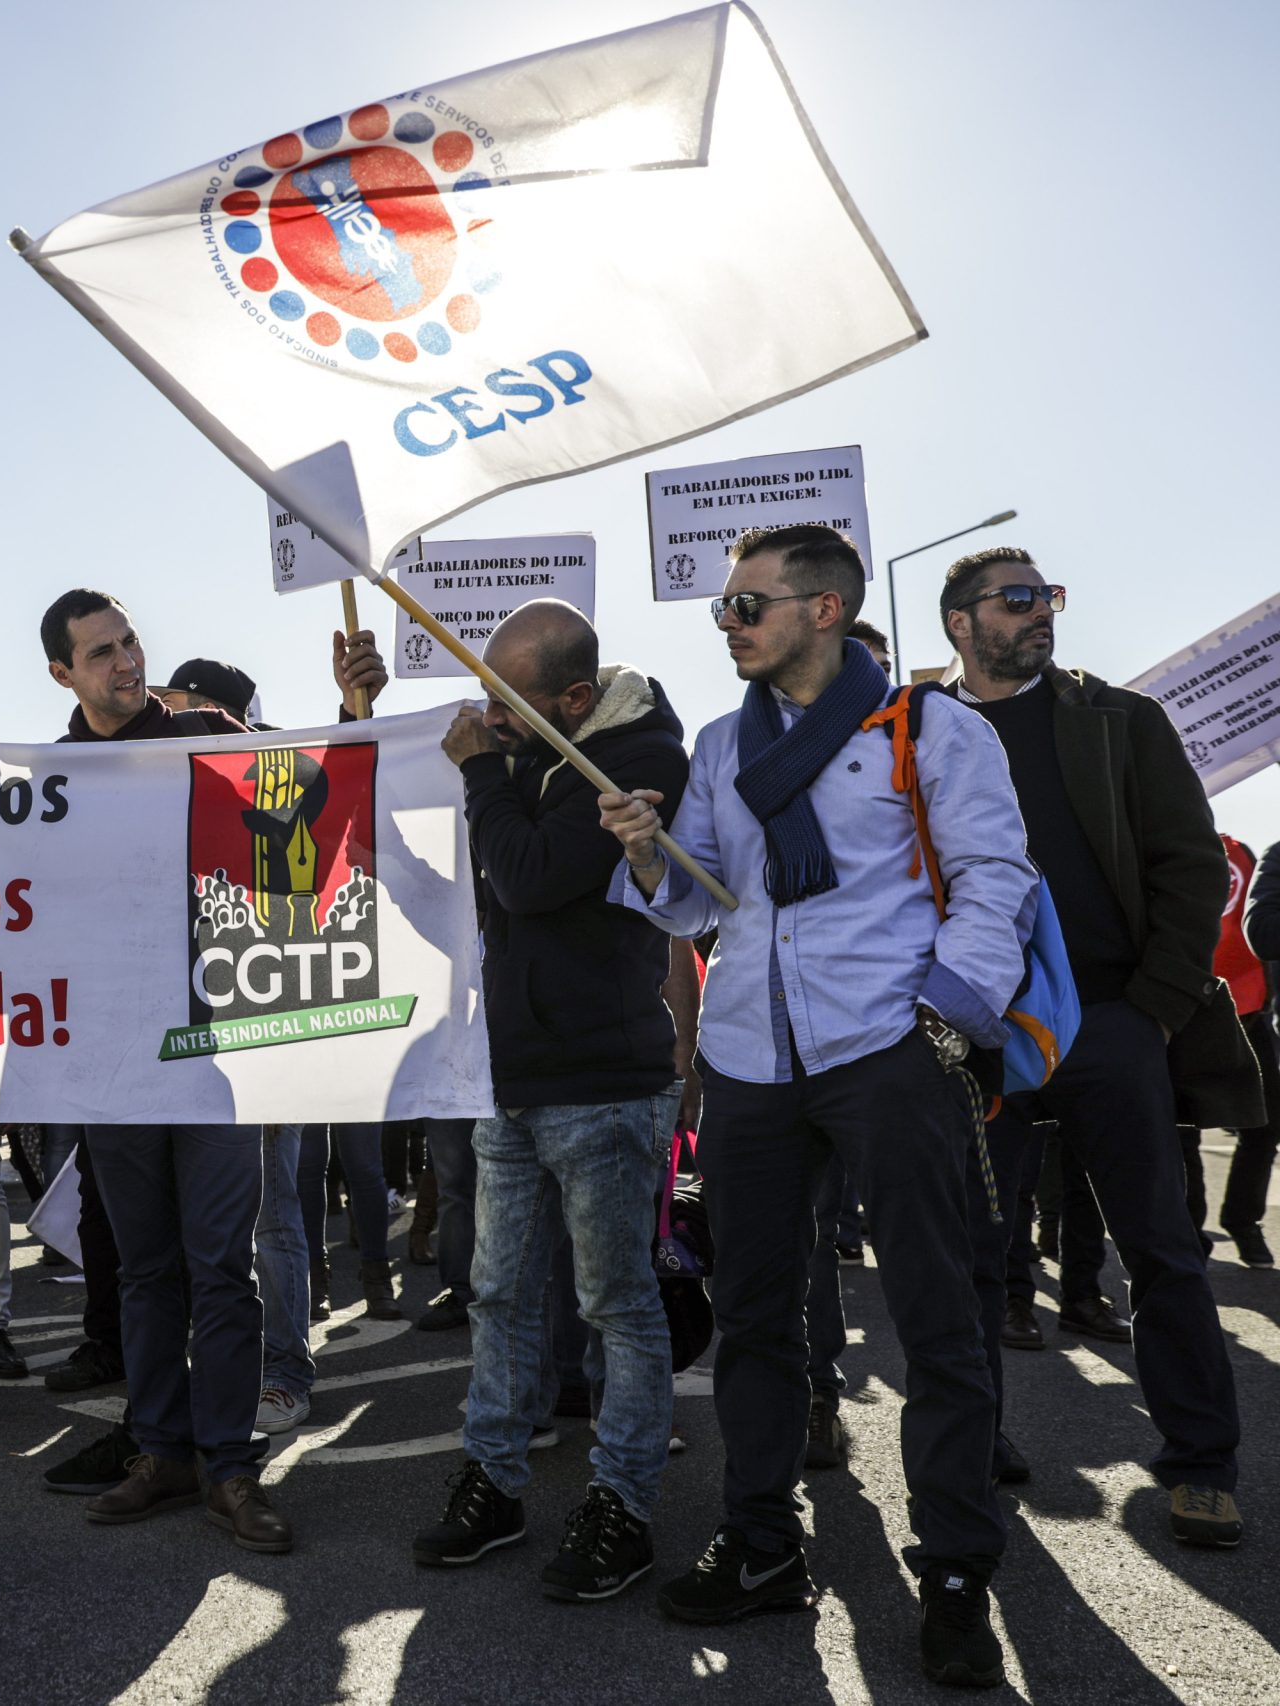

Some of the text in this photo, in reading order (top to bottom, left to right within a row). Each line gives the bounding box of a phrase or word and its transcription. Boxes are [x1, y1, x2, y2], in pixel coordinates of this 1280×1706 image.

[410, 91, 422, 103] E
[424, 95, 495, 149] SERVIÇOS
[206, 176, 224, 196] DO
[240, 299, 267, 326] DOS
[393, 350, 593, 457] CESP
[661, 468, 854, 496] TRABALHADORES DO LIDL
[693, 487, 822, 510] EM LUTA EXIGEM:
[668, 527, 737, 545] REFORÇO
[832, 518, 852, 530] DE
[408, 555, 586, 574] TRABALHADORES DO LIDL
[433, 573, 555, 589] EM LUTA EXIGEM:
[669, 582, 694, 590] CESP
[476, 610, 495, 622] DO
[460, 627, 494, 639] PESS
[1157, 630, 1280, 704] ABALHADORES DO LID
[1176, 654, 1274, 709] EM LUTA EXIGEM:
[1223, 697, 1273, 727] TODOS OS
[1224, 698, 1246, 713] DOS
[192, 941, 372, 1007] CGTP
[170, 1002, 401, 1052] INTERSINDICAL NACIONAL
